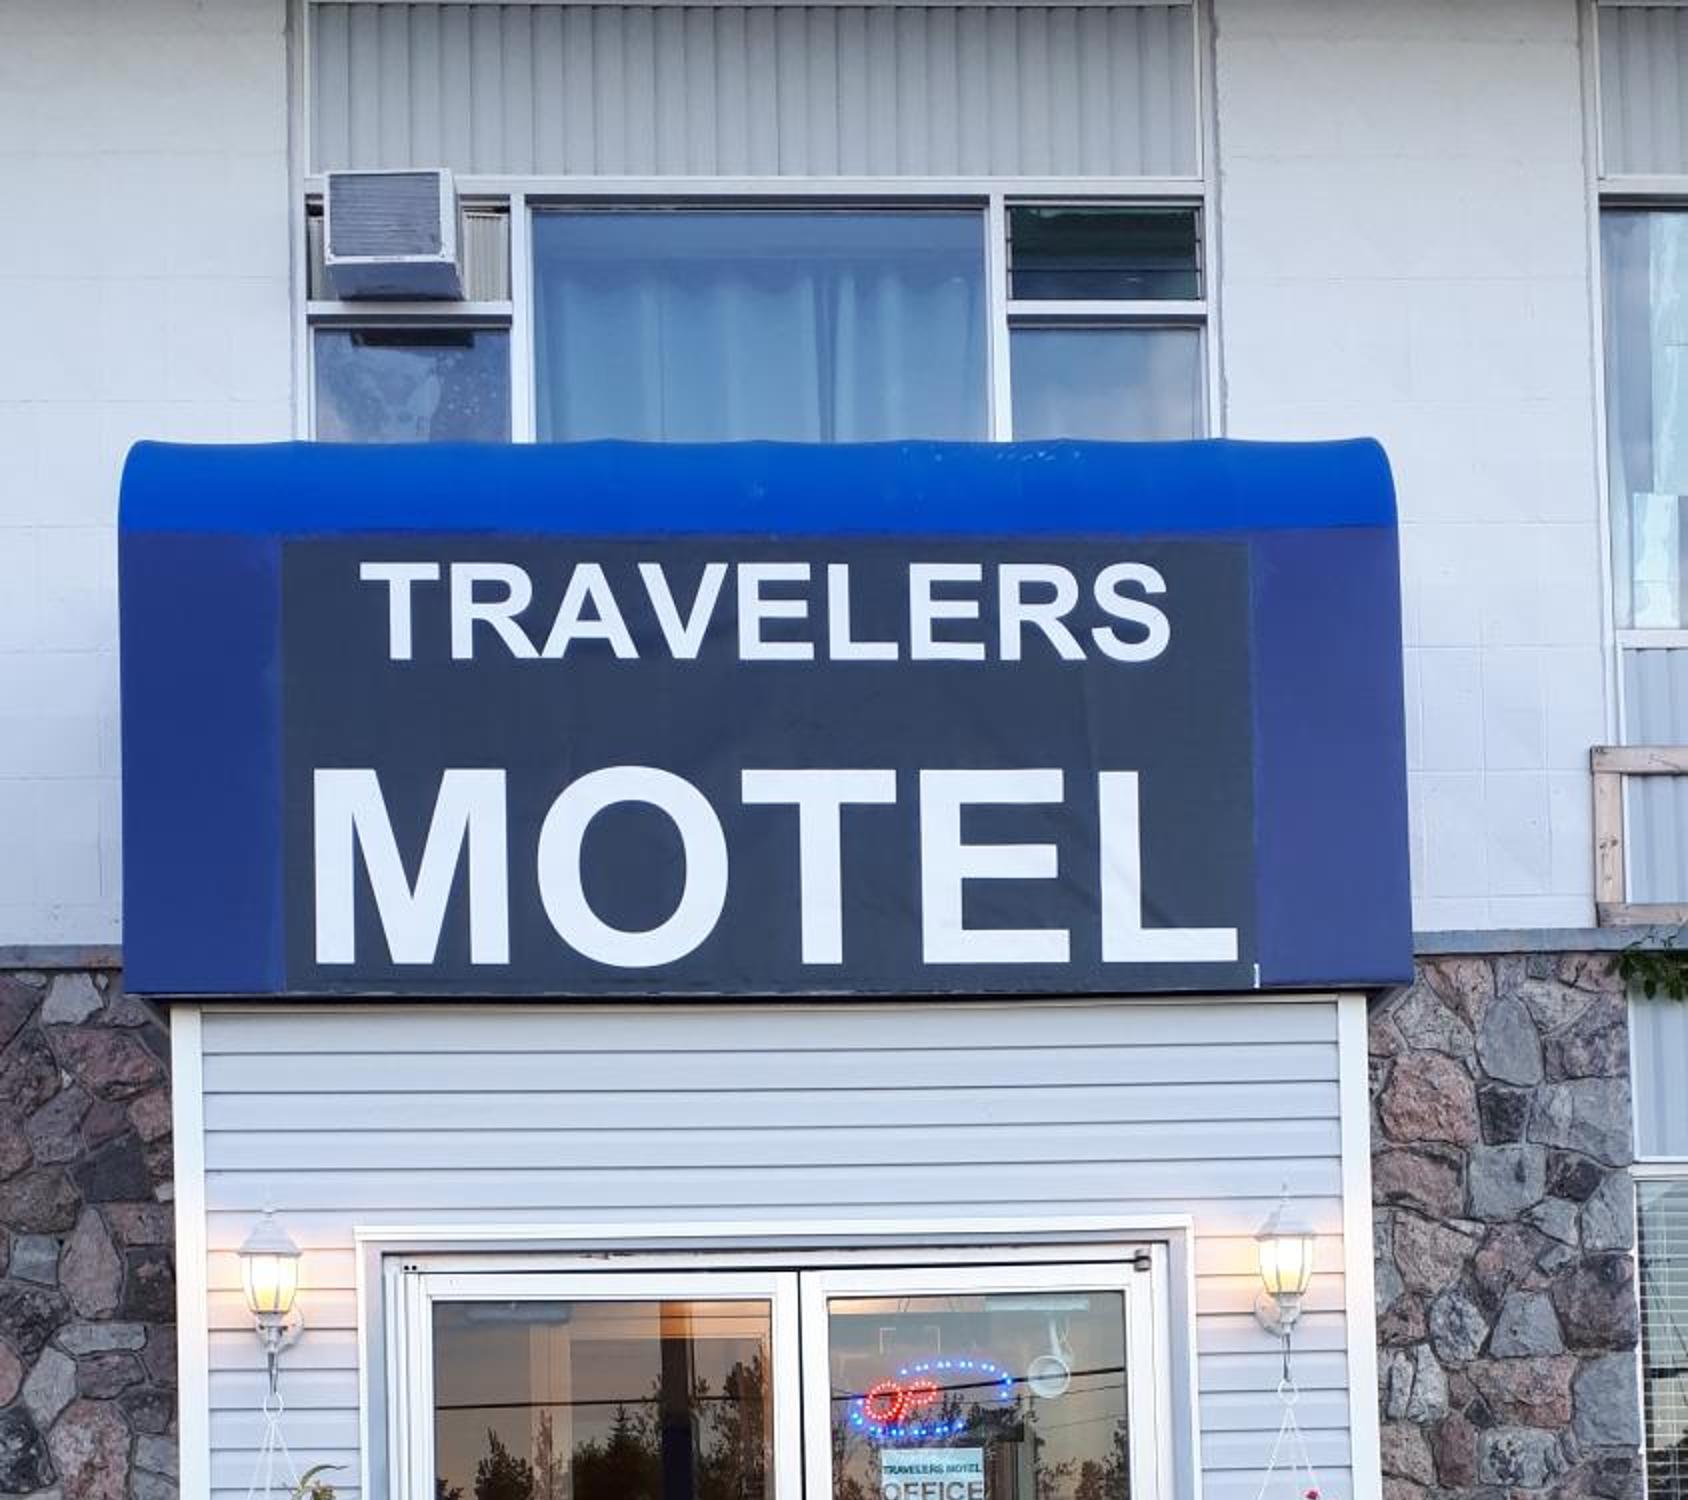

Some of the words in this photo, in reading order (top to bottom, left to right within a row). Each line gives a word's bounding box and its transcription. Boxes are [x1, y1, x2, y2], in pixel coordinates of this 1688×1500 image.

[360, 562, 1170, 663] TRAVELERS
[313, 765, 1239, 968] MOTEL
[883, 1464, 944, 1475] TRAVELERS
[946, 1463, 982, 1473] MOTEL
